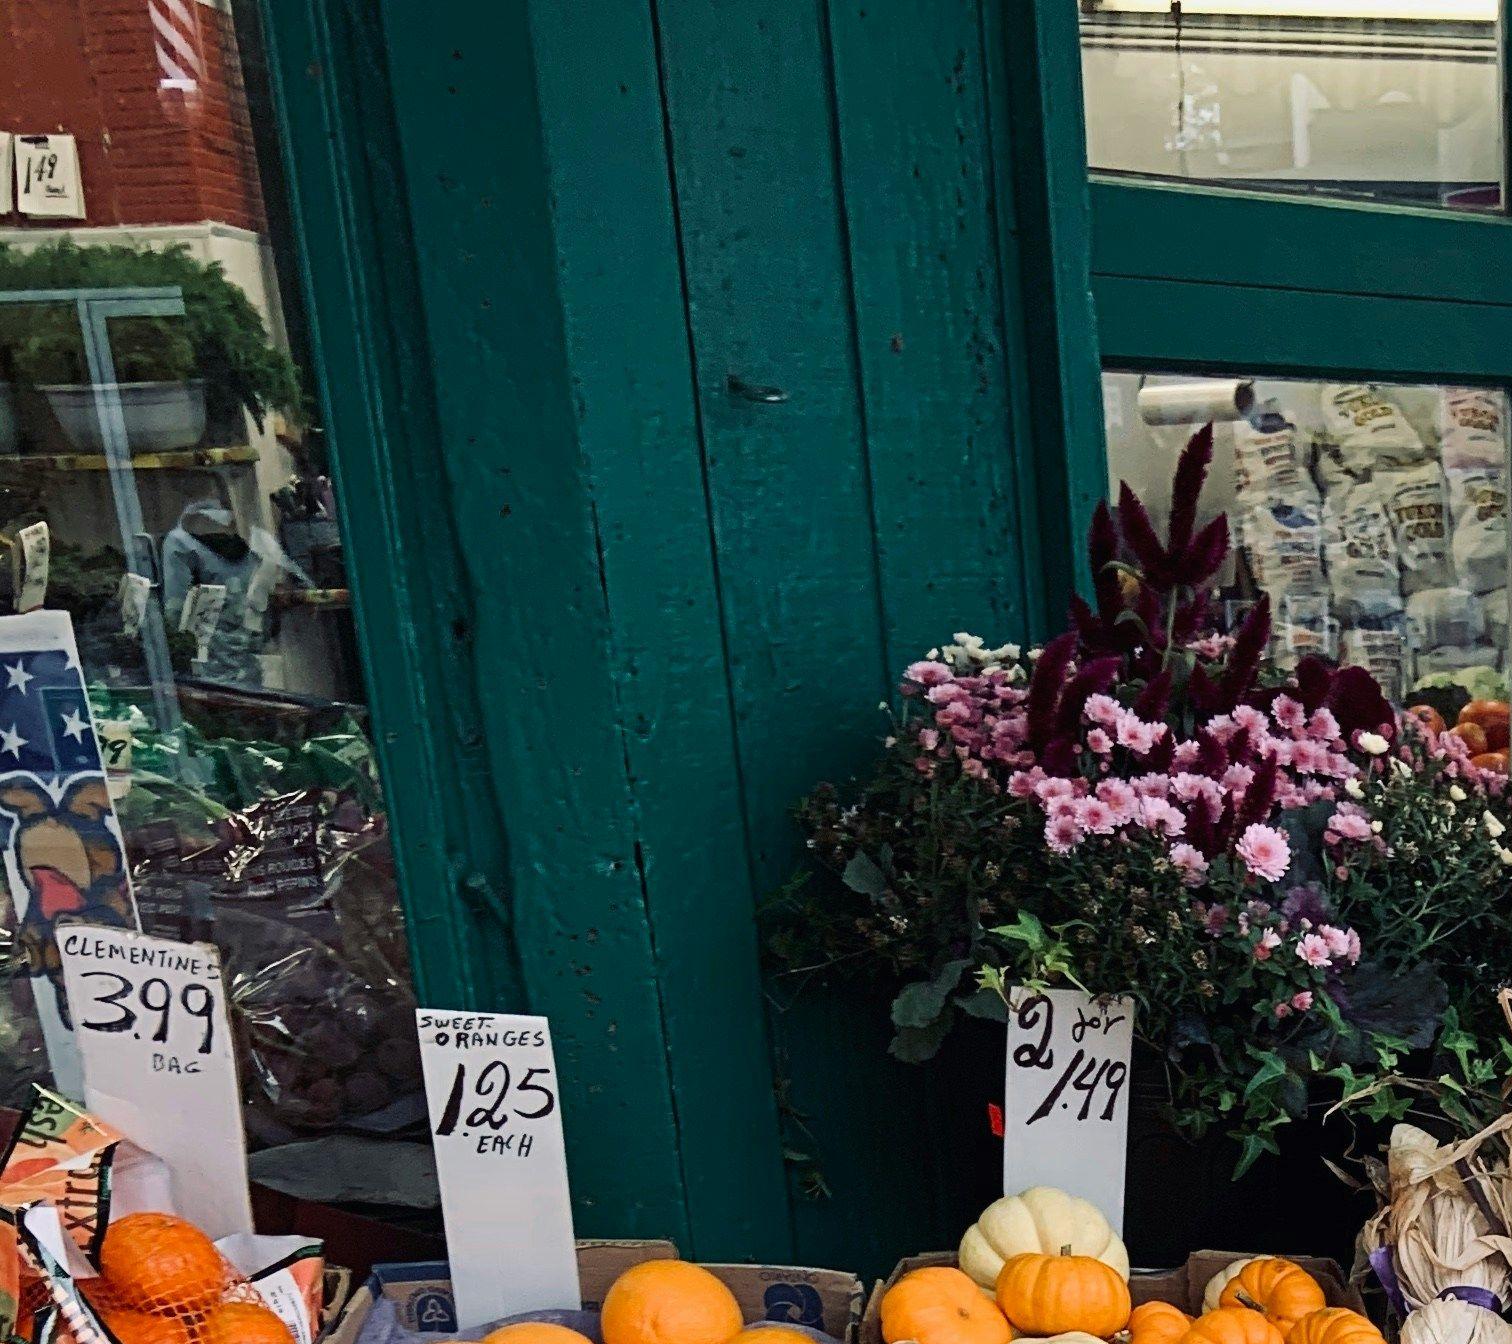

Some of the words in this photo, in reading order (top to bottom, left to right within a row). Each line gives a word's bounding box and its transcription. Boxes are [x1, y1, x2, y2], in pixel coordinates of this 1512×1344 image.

[80, 970, 215, 1055] 3.99
[434, 1030, 546, 1050] ORANGES
[1013, 994, 1054, 1070] 2
[1071, 1006, 1126, 1043] for
[152, 1052, 203, 1074] BAG
[434, 1060, 555, 1138] 1.25
[1025, 1048, 1127, 1126] 1.49
[476, 1133, 534, 1158] EACH
